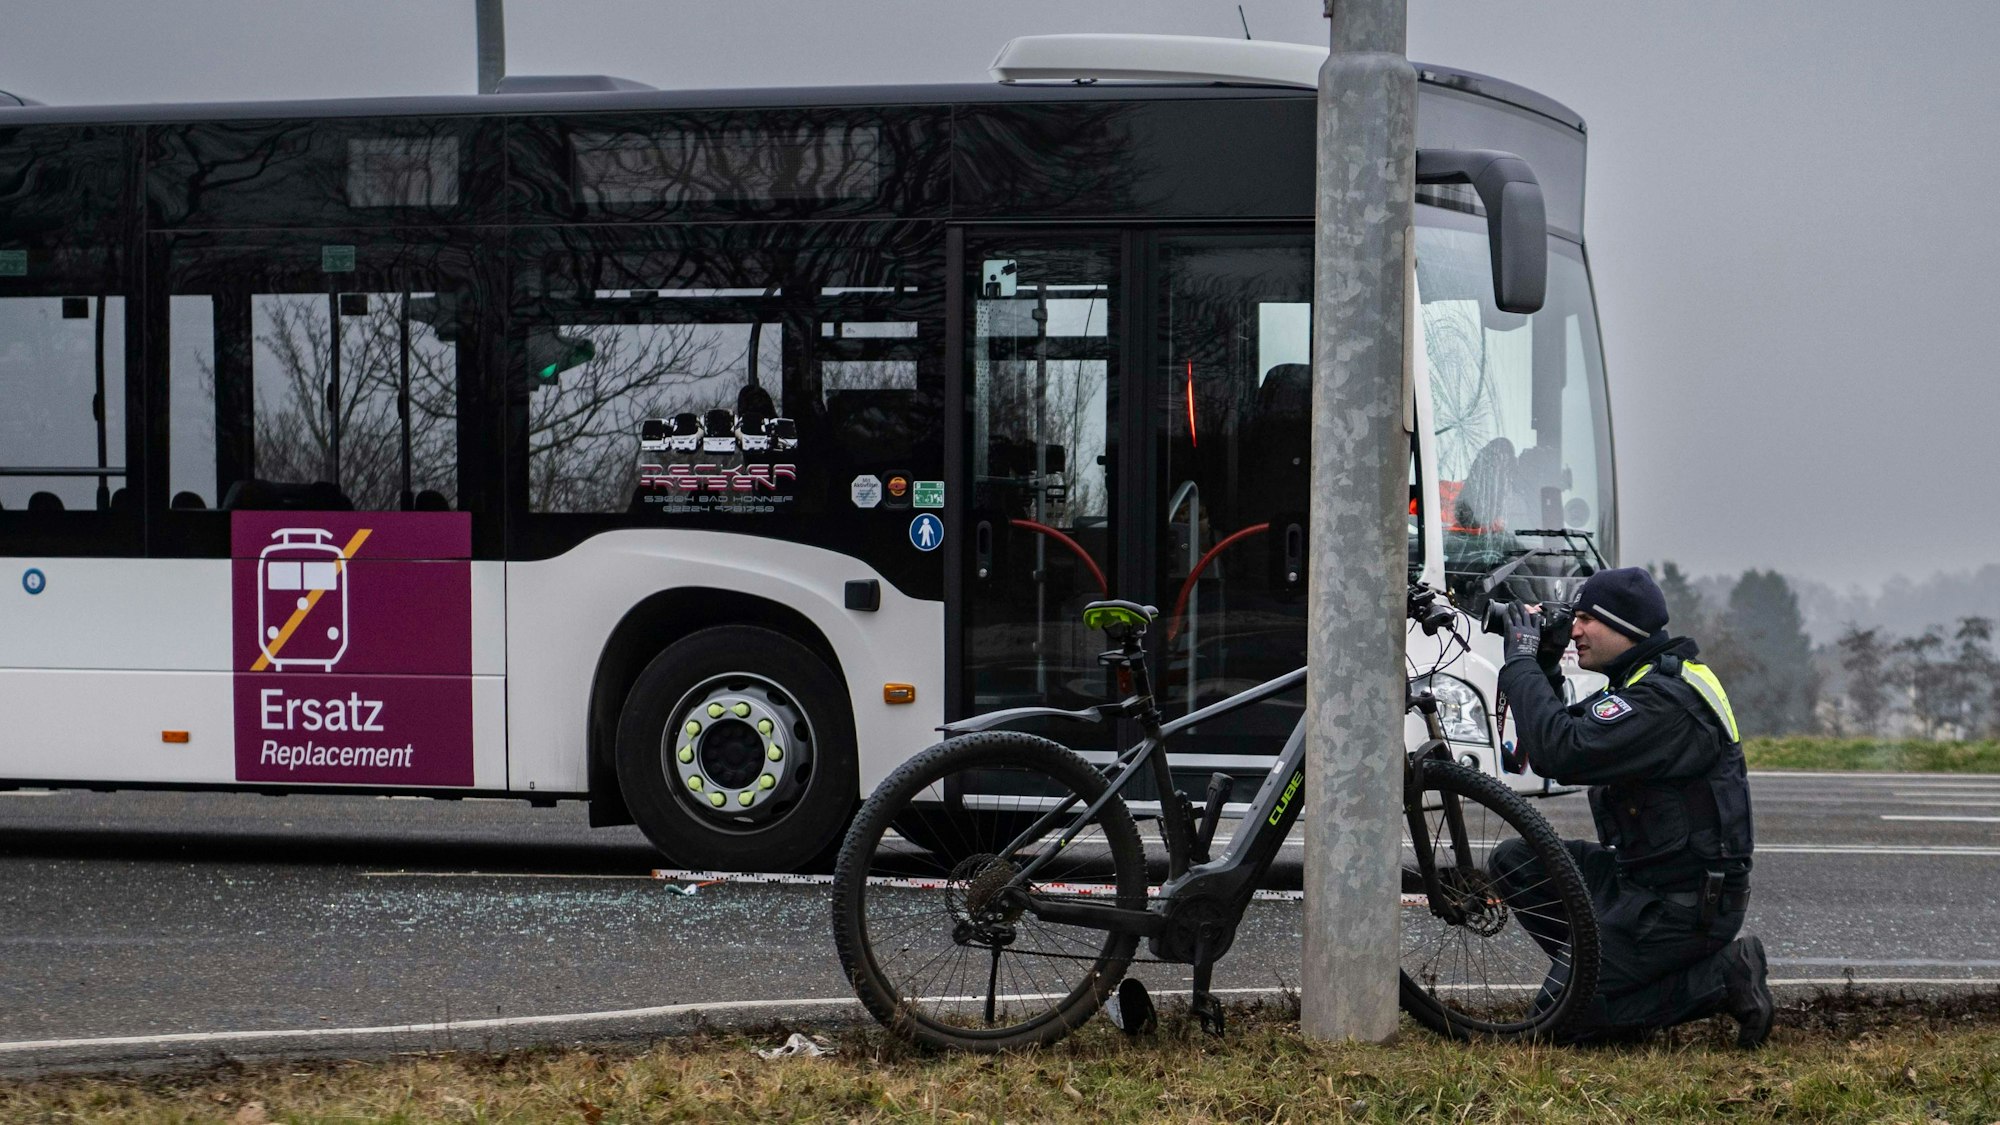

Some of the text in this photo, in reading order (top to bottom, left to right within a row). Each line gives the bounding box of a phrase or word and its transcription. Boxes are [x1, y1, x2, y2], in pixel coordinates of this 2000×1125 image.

[640, 464, 797, 480] DECKER
[640, 474, 777, 491] REISEN
[260, 688, 385, 732] Ersatz
[260, 739, 414, 771] Replacement
[1268, 770, 1304, 826] CUBE
